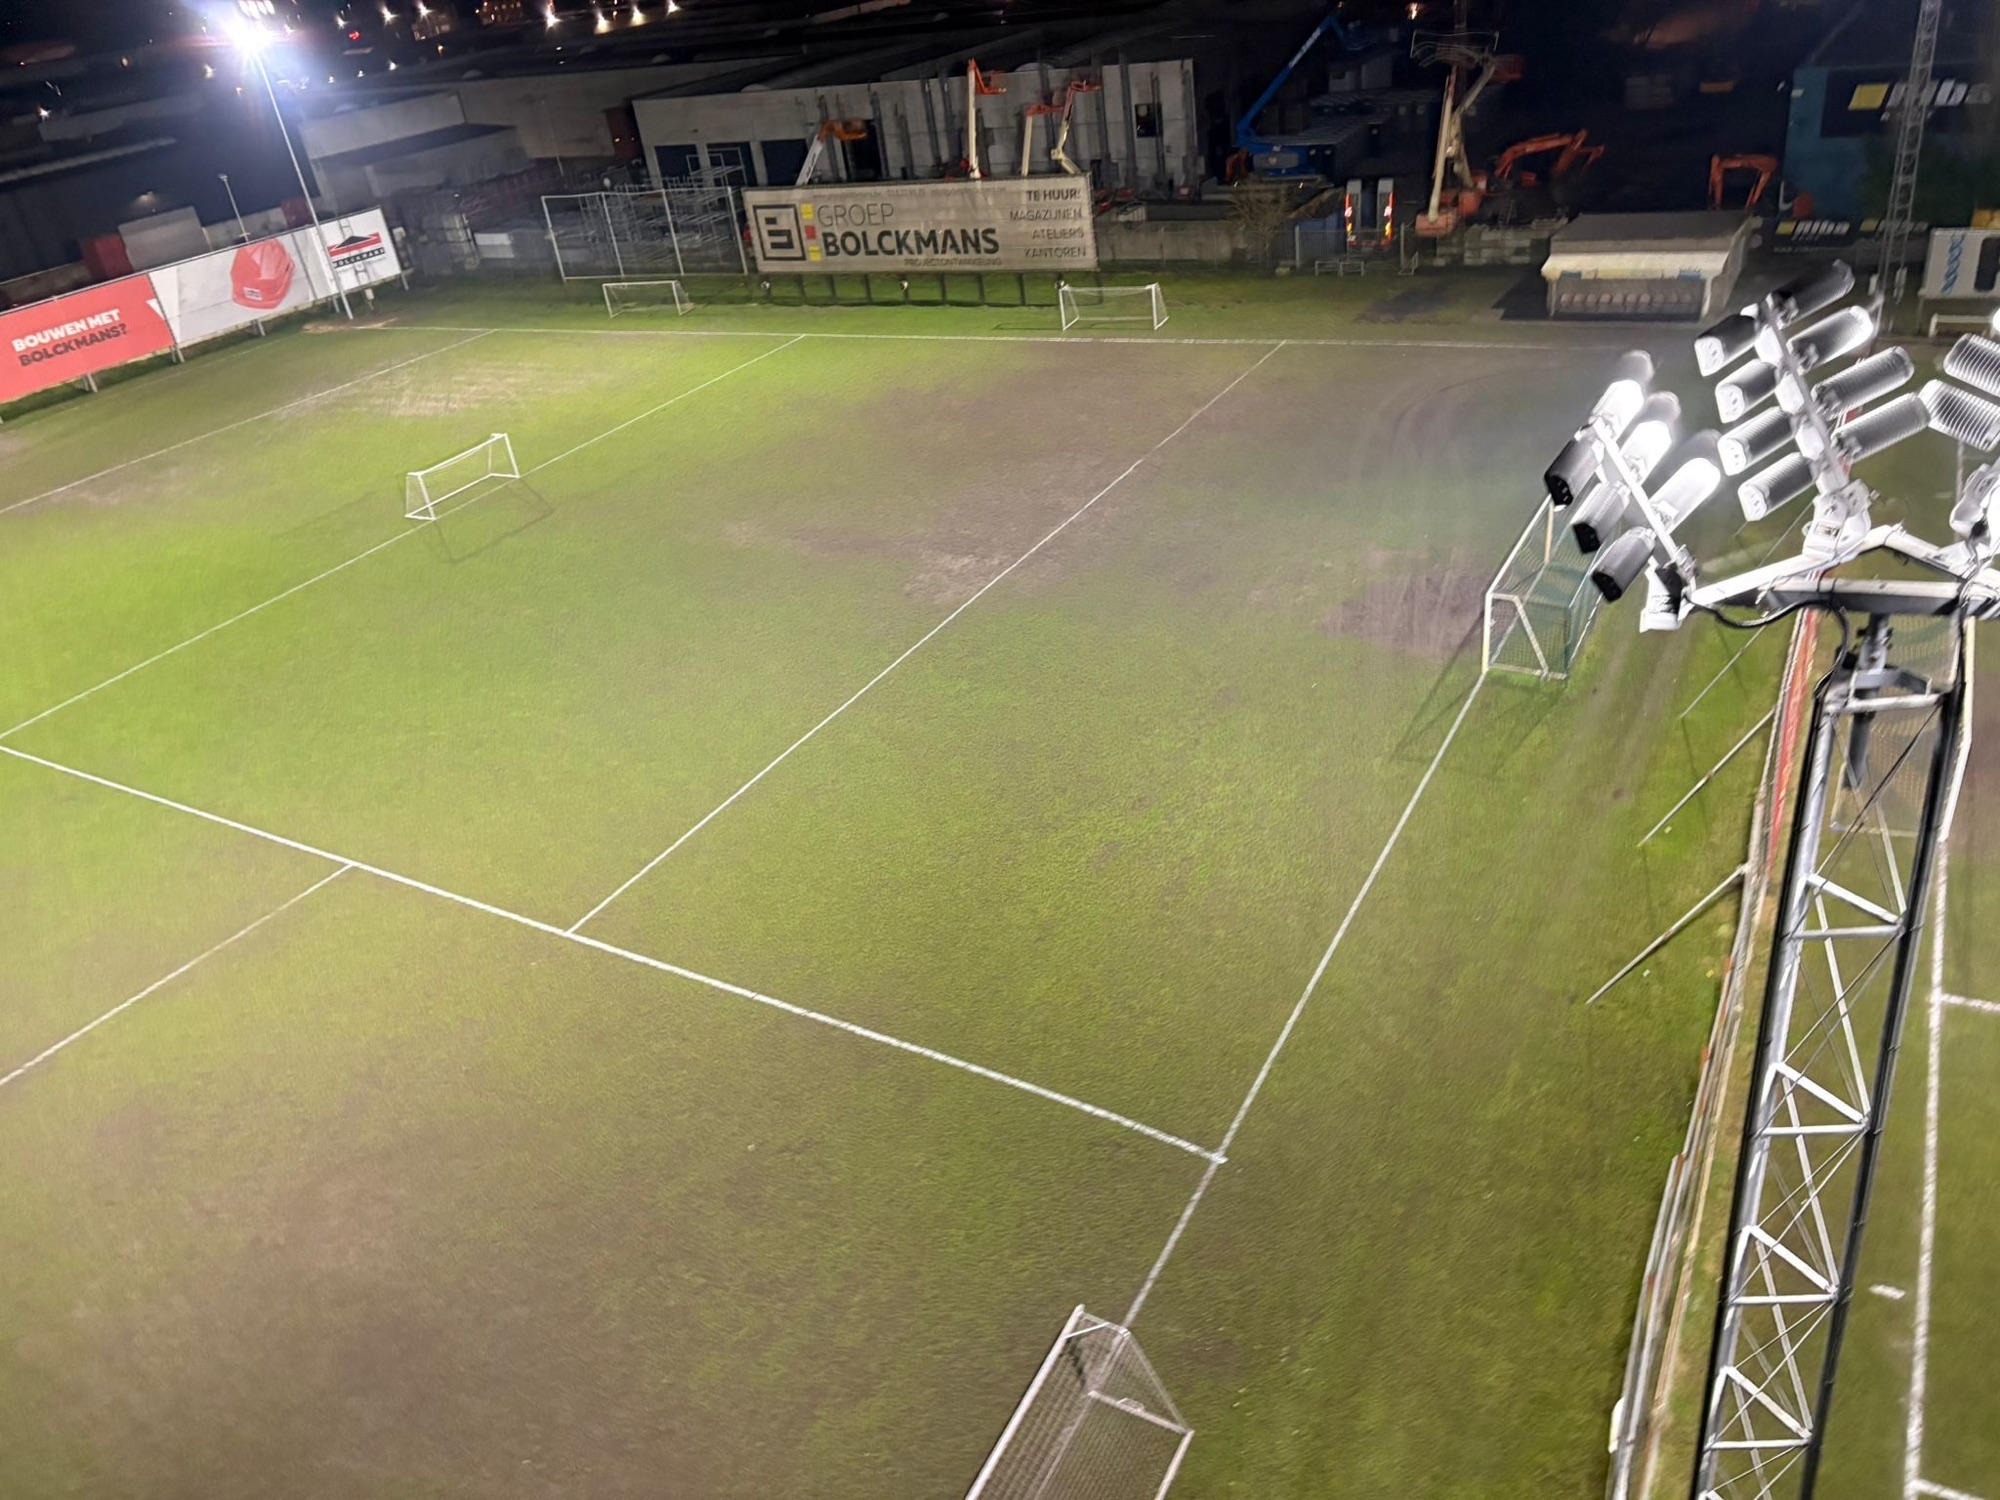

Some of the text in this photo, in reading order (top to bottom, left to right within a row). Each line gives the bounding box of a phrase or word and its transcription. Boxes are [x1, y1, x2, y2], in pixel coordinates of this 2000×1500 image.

[1026, 190, 1040, 201] TE
[817, 203, 894, 227] GROEP
[1010, 208, 1082, 220] MAGAZIJNEN
[821, 227, 1000, 257] BOLCKMANS
[1032, 227, 1085, 239] ATELIERS
[1024, 245, 1086, 258] KANTOREN
[11, 308, 120, 352] BOUWEN MET
[18, 323, 127, 366] BOLCKMANS?
